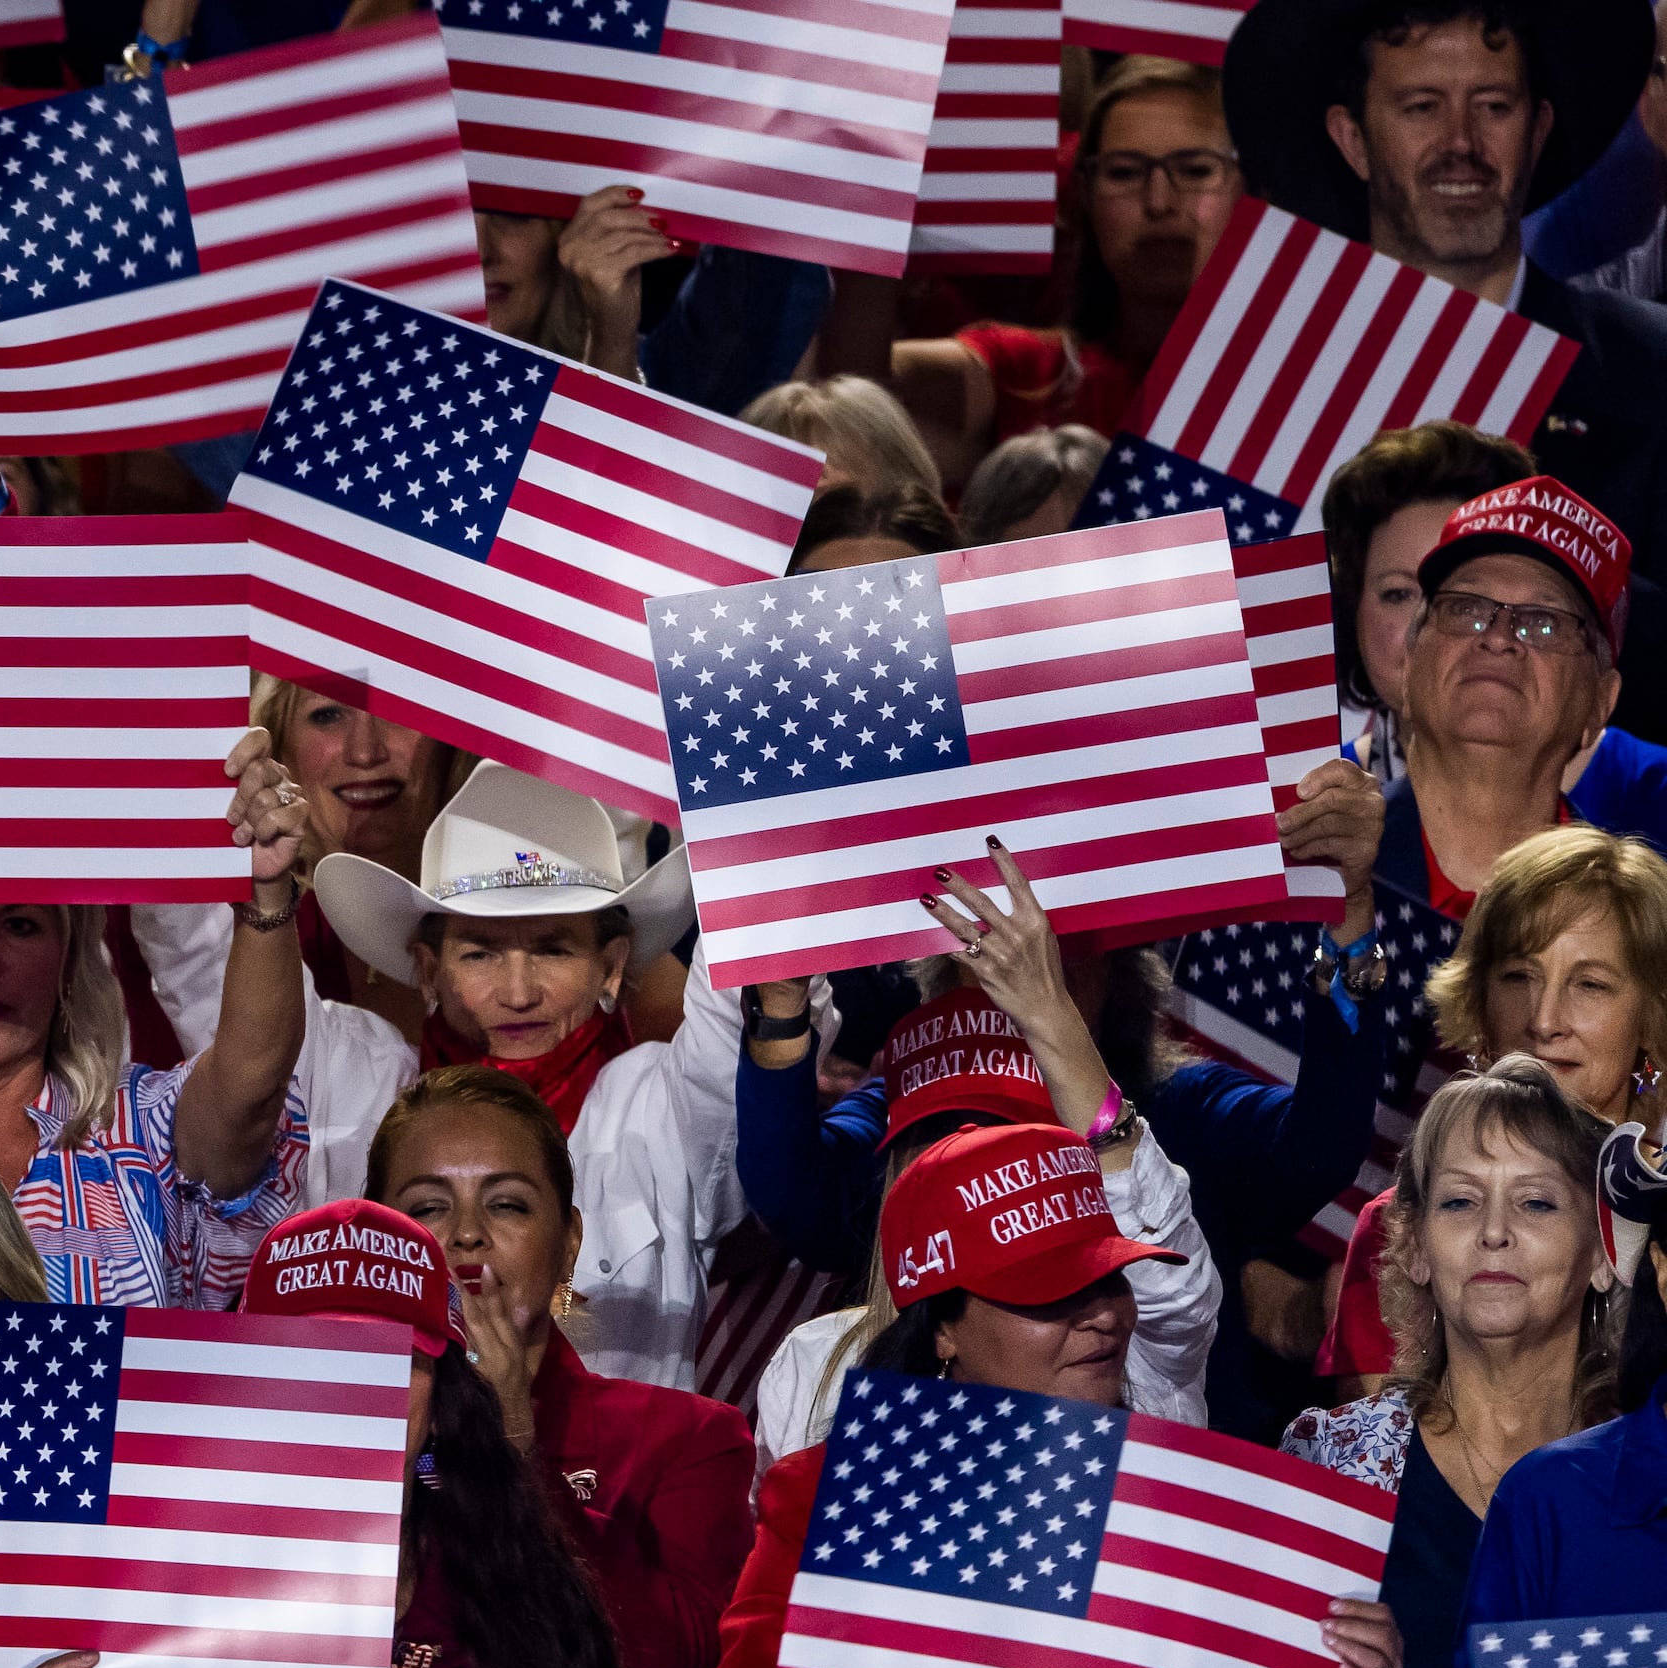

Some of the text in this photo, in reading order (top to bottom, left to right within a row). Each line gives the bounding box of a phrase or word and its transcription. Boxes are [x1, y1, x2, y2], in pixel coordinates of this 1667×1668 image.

[1455, 486, 1619, 562] MAKE AMERICA
[1533, 520, 1602, 580] AGAIN
[891, 1015, 945, 1065] MAKE
[900, 1050, 965, 1097] GREAT
[955, 1158, 1036, 1212] MAKE
[990, 1193, 1072, 1245] GREAT
[267, 1223, 435, 1271] MAKE AMERICA
[897, 1229, 956, 1290] 45-47
[276, 1260, 424, 1301] GREAT AGAIN
